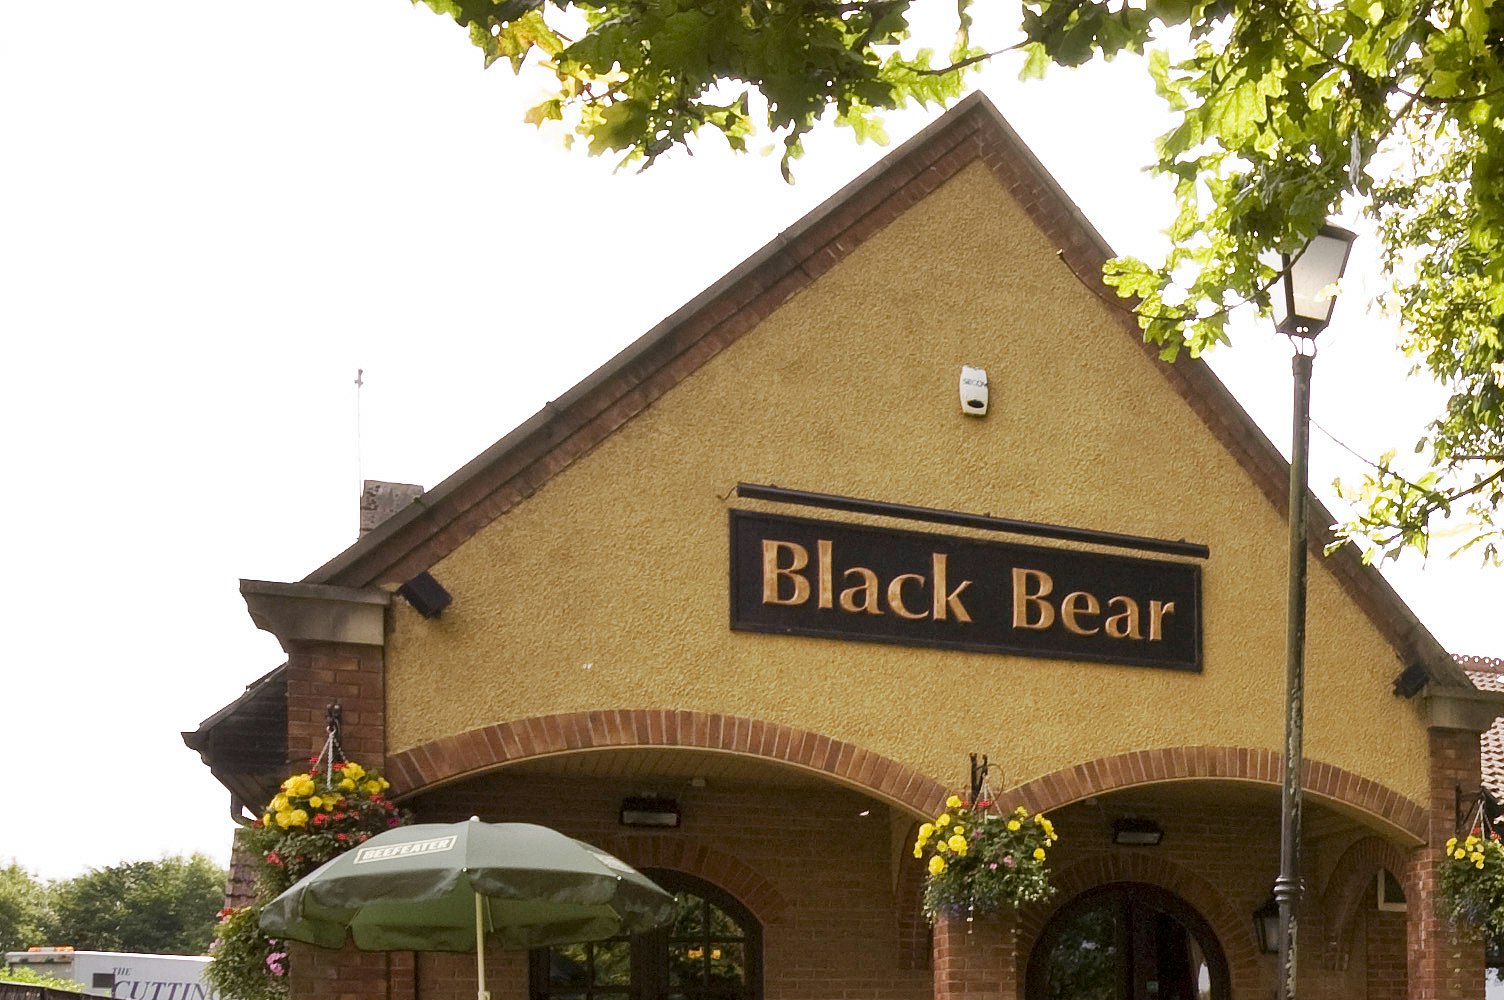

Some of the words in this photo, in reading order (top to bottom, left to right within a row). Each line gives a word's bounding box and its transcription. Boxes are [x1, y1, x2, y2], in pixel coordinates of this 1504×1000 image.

[762, 539, 972, 622] Black
[1012, 567, 1175, 641] Bear
[362, 839, 450, 860] BEEFEATER
[113, 967, 132, 976] THE
